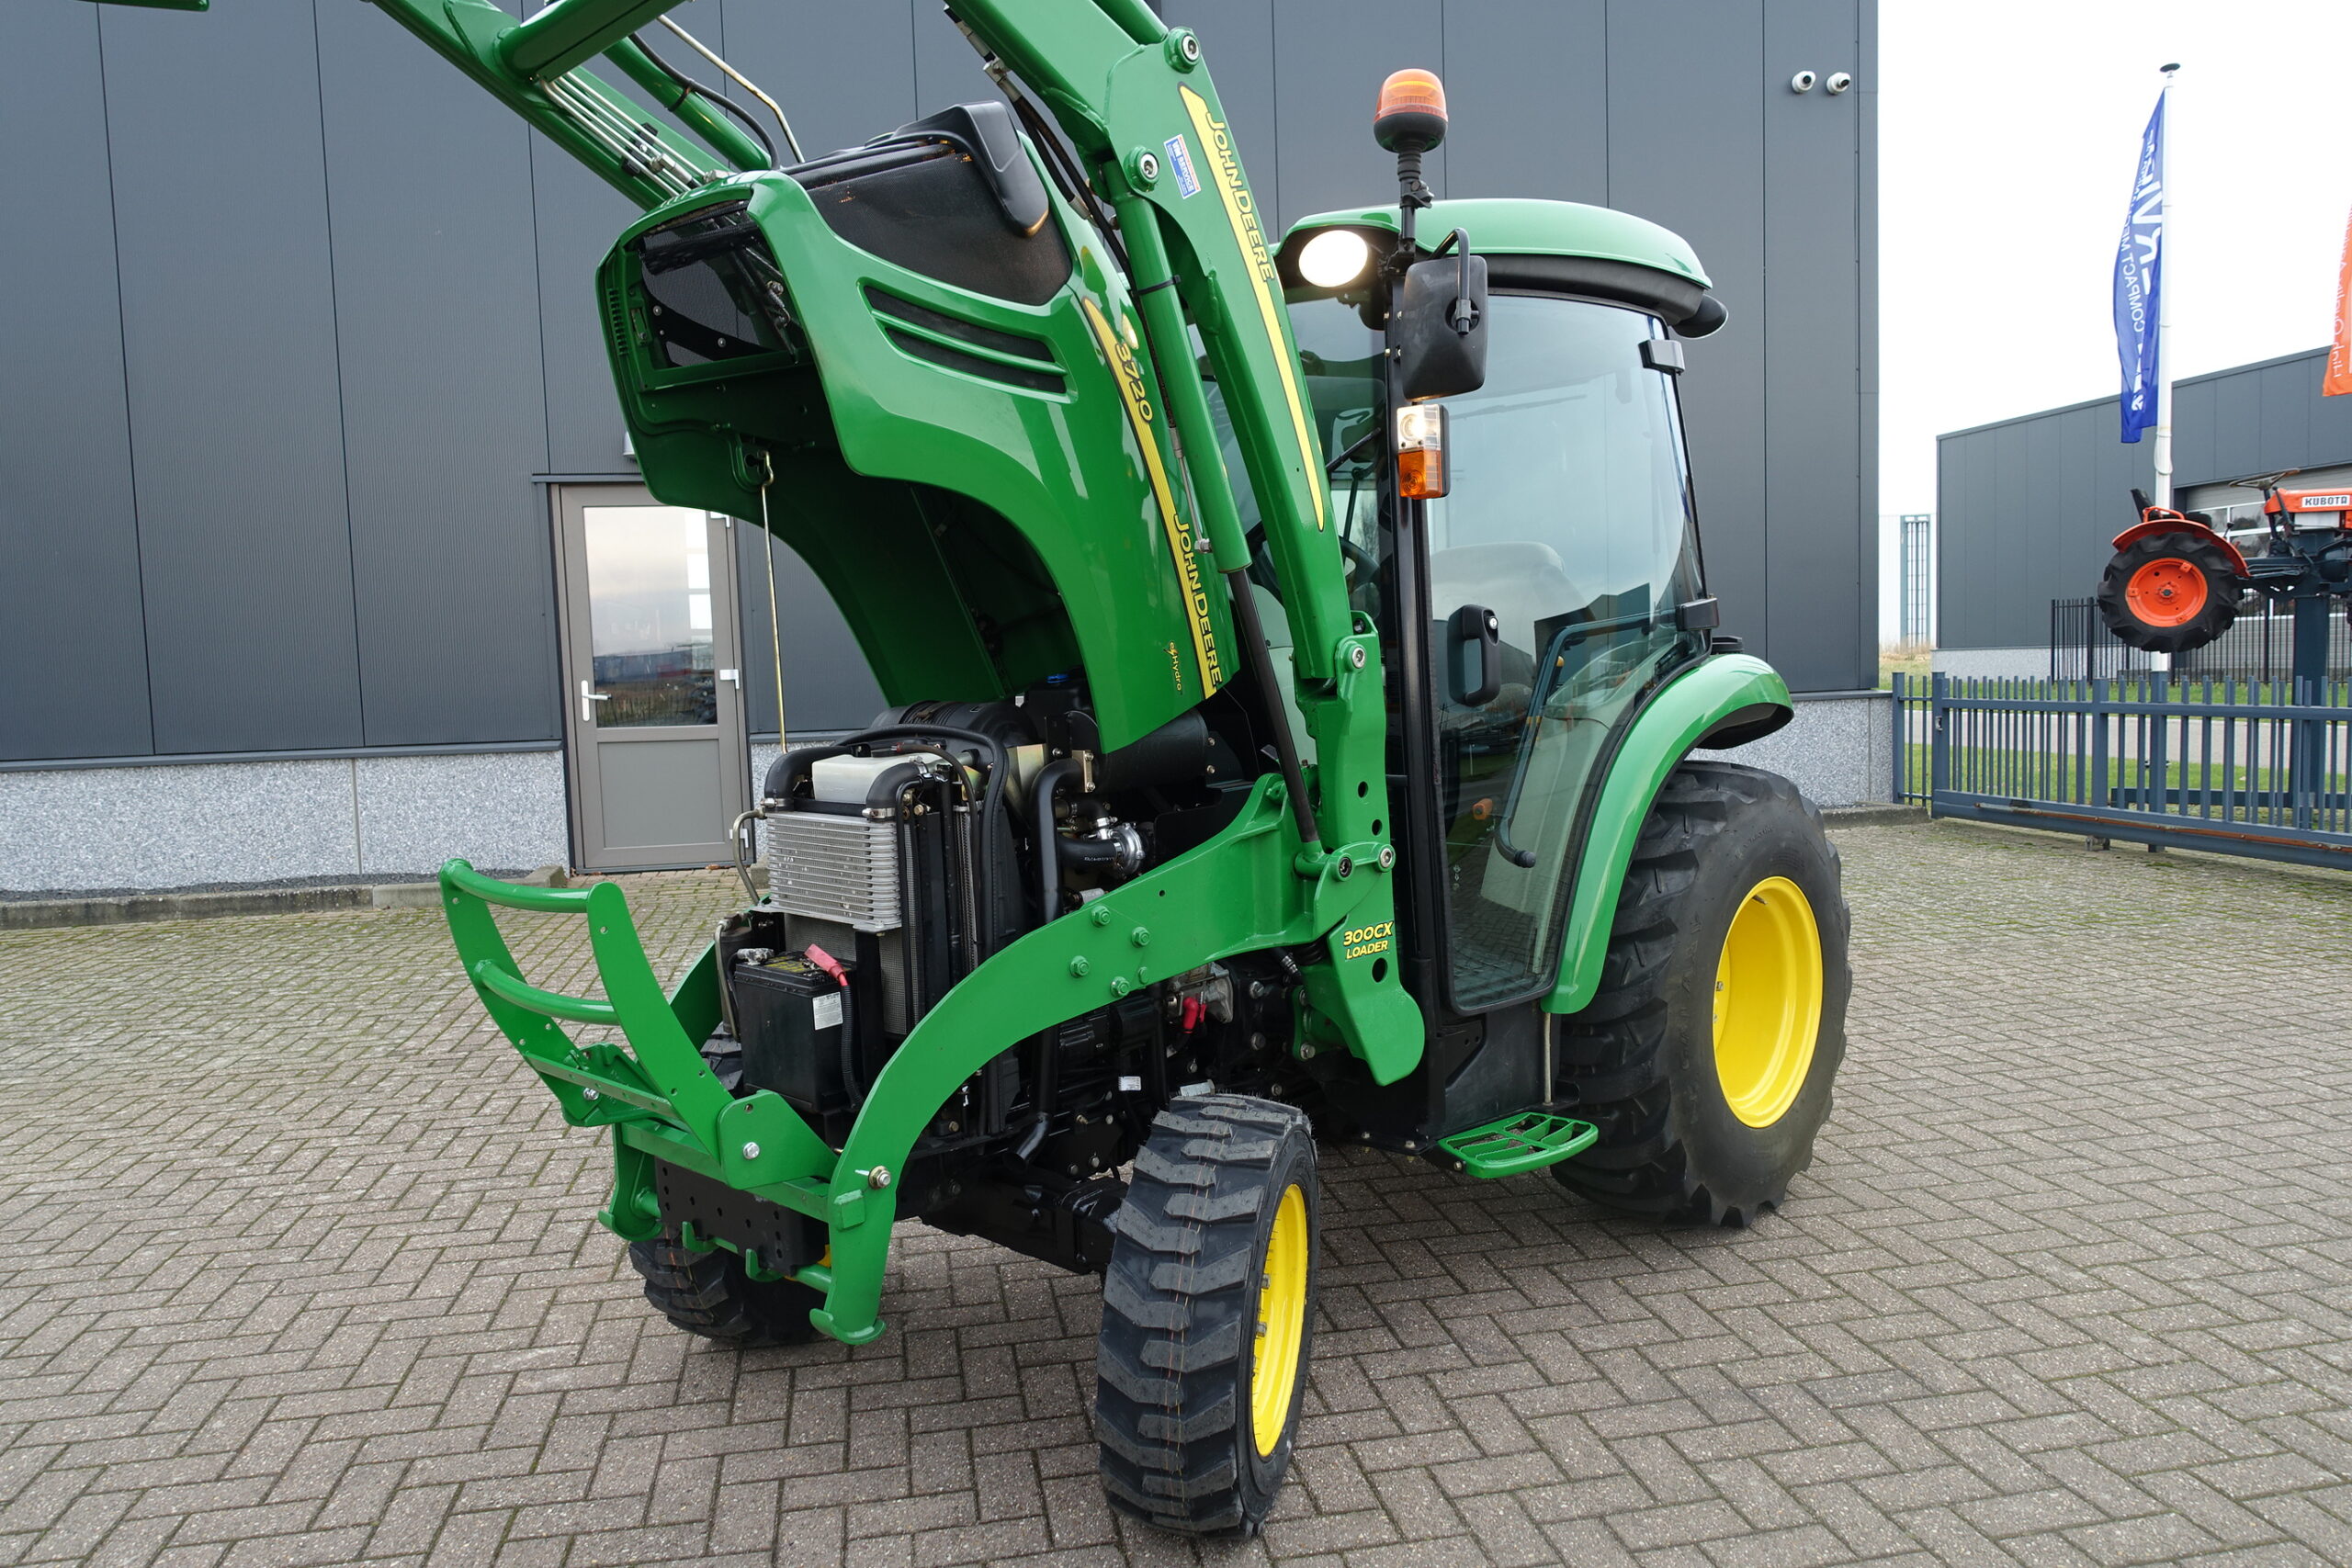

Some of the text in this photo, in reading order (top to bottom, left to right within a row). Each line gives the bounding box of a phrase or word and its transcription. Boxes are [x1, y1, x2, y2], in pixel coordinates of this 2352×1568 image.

[1177, 156, 1195, 192] SERVICE
[1205, 112, 1275, 283] JOHN DEERE
[1115, 343, 1153, 423] 3720
[2304, 496, 2348, 506] KUBOTA
[1174, 513, 1223, 687] JOHN DEERE
[1343, 920, 1394, 946] 300CX
[1346, 940, 1389, 960] LOADER
